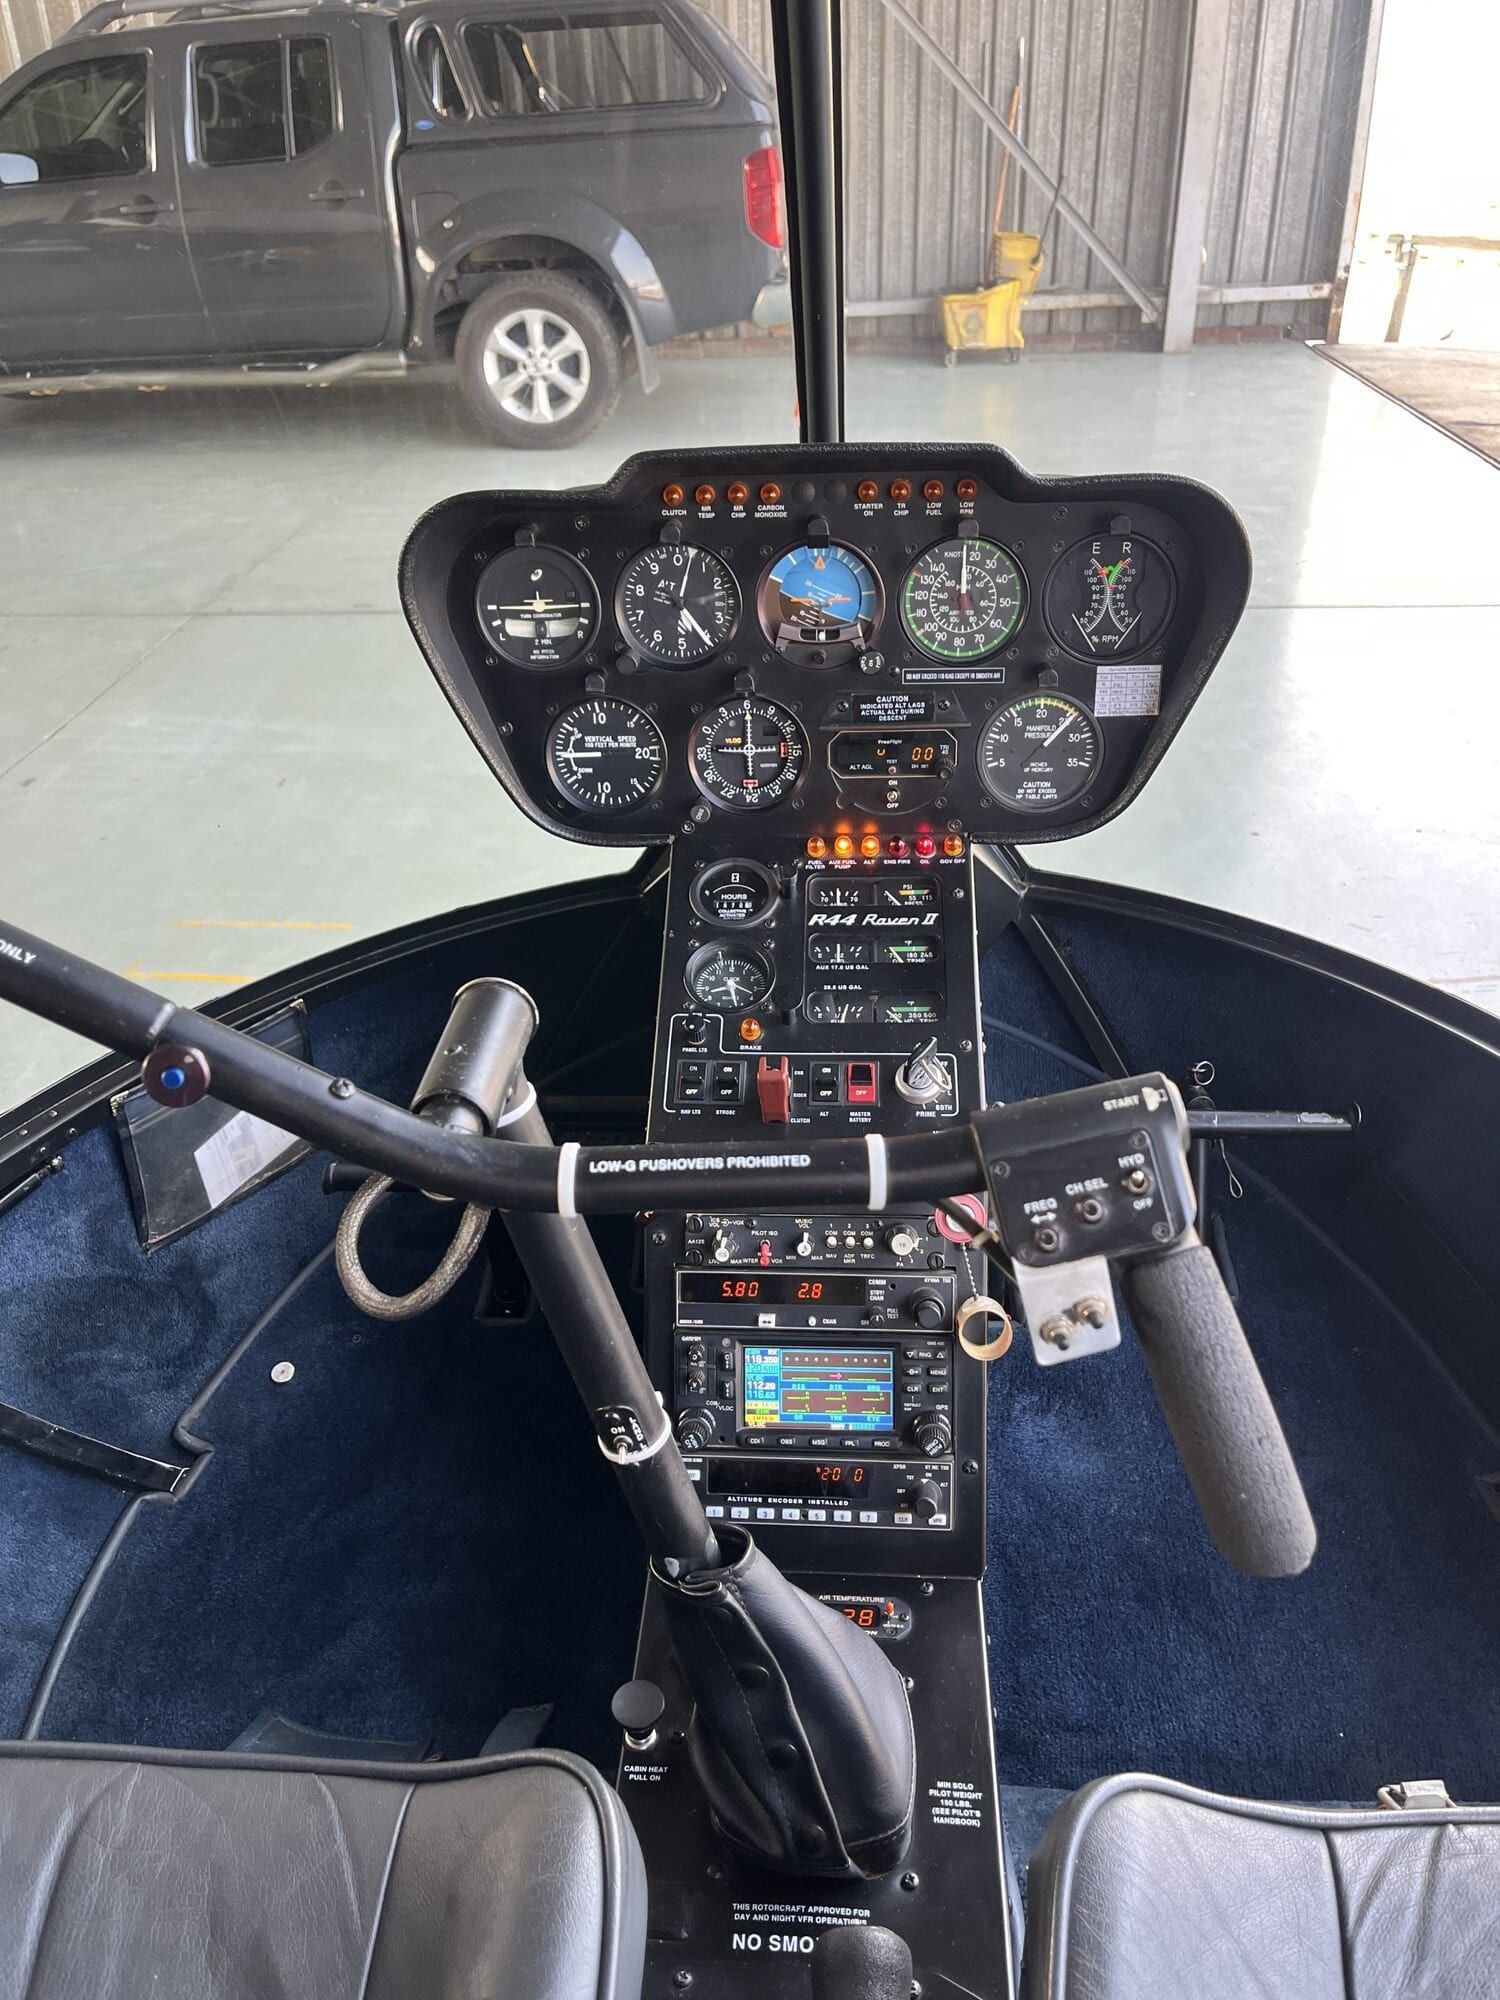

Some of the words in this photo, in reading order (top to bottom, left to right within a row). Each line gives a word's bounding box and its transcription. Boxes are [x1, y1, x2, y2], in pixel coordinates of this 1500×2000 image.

[1092, 542, 1101, 554] E
[1122, 542, 1132, 554] R
[969, 552, 981, 560] 20
[930, 563, 945, 572] 140
[984, 560, 997, 568] 30
[920, 575, 934, 584] 130
[996, 574, 1008, 583] 40
[914, 591, 928, 599] 120
[999, 598, 1011, 607] 50
[916, 608, 927, 617] 110
[924, 623, 938, 631] 100
[990, 619, 1002, 628] 60
[499, 632, 506, 641] L
[577, 631, 584, 639] R
[935, 632, 947, 641] 90
[974, 634, 985, 643] 70
[953, 637, 965, 646] 80
[593, 712, 606, 724] 10
[1036, 709, 1047, 718] 20
[783, 720, 796, 732] 12
[1014, 718, 1023, 726] 15
[1000, 734, 1009, 742] 10
[1068, 734, 1081, 742] 30
[635, 747, 650, 759] 20
[697, 747, 707, 760] 33
[792, 744, 802, 756] 15
[1066, 758, 1078, 767] 35
[786, 768, 798, 780] 18
[597, 782, 611, 793] 10
[808, 914, 858, 926] R44
[861, 914, 919, 926] Raven
[922, 913, 939, 925] II
[1103, 1095, 1140, 1111] START
[589, 1159, 636, 1173] LOW-G
[639, 1157, 724, 1172] PUSHOVERS
[727, 1154, 811, 1169] PROHIBITED
[1117, 1153, 1145, 1168] HYD
[1065, 1181, 1084, 1196] CH
[1084, 1177, 1109, 1191] SEL
[1023, 1197, 1058, 1215] FREQ
[1133, 1198, 1154, 1210] OFF
[722, 1281, 759, 1297] 5.80
[797, 1282, 823, 1299] 2.8
[610, 1426, 626, 1434] ON
[832, 1595, 885, 1603] TEMPERATURE
[937, 1781, 951, 1789] MIN
[952, 1782, 974, 1790] SOLO
[929, 1789, 952, 1797] PILOT
[953, 1791, 983, 1800] WEIGHT
[954, 1800, 973, 1808] LBS.
[932, 1807, 950, 1815] (SEE
[952, 1809, 981, 1817] PILOT'S
[933, 1816, 981, 1828] HANDBOOK)
[732, 1903, 750, 1911] THIS
[752, 1903, 806, 1913] ROTORCRAFT
[807, 1906, 851, 1916] APPROVED
[853, 1908, 871, 1918] FOR
[734, 1913, 751, 1921] DAY
[771, 1914, 795, 1923] NIGHT
[797, 1915, 814, 1924] VFR
[732, 1934, 761, 1950] NO
